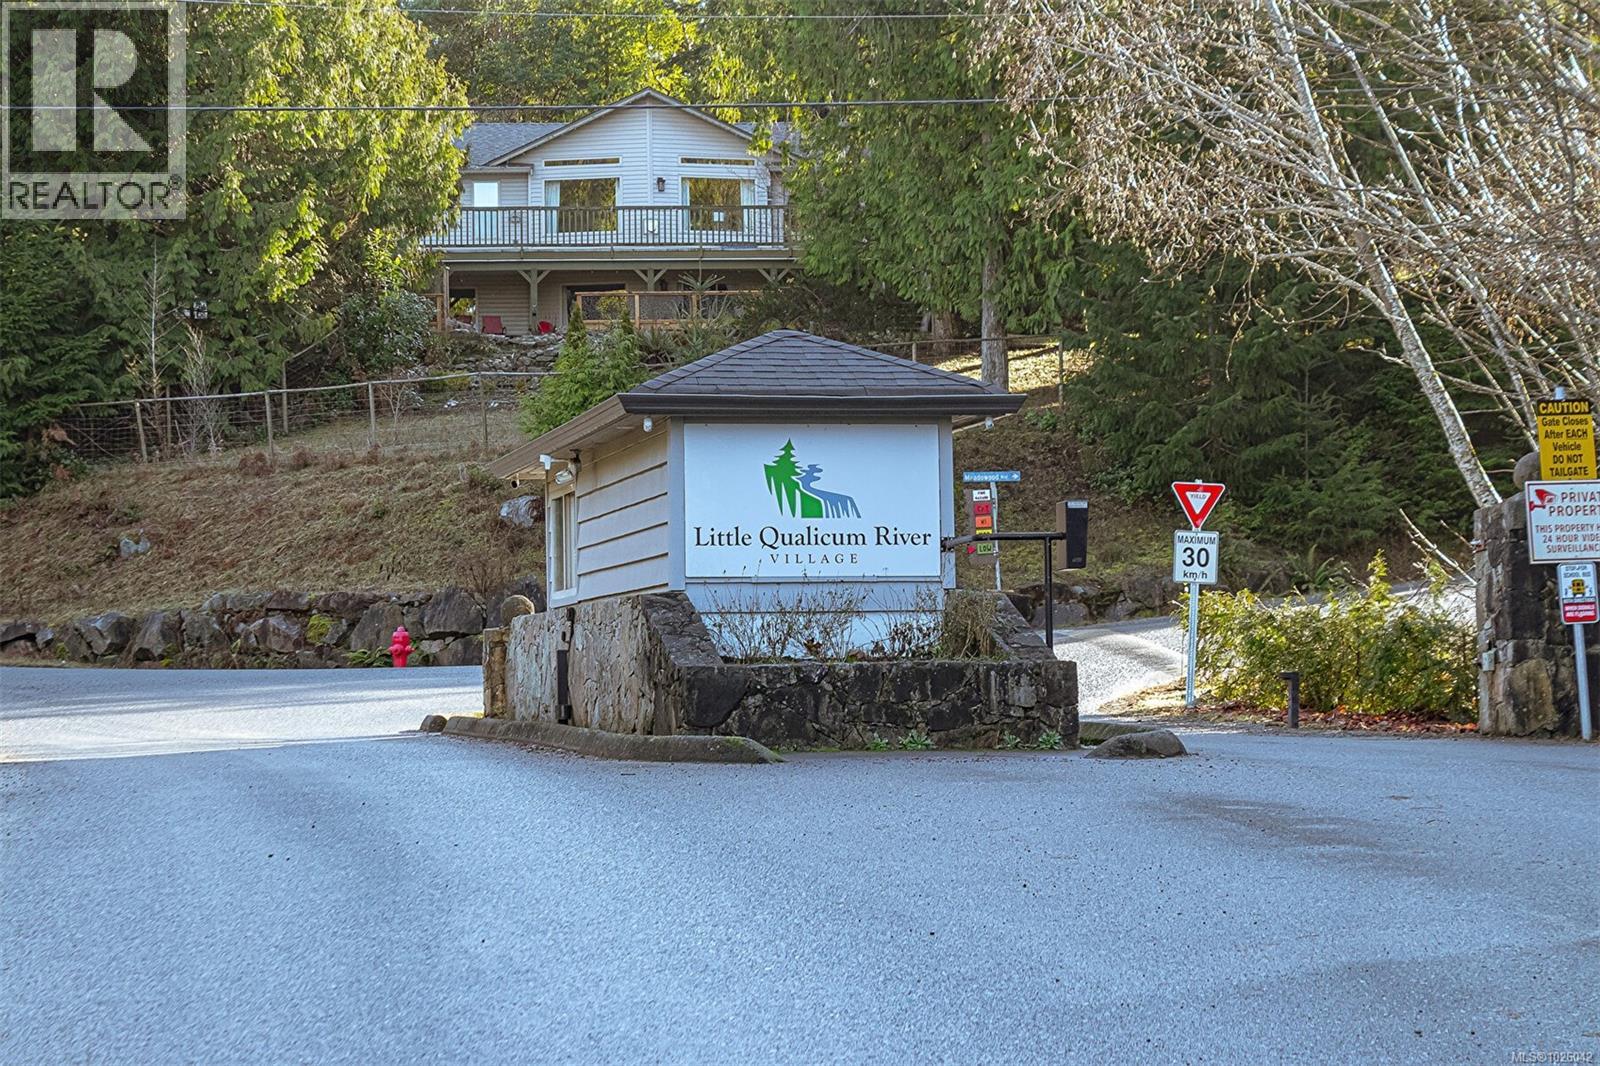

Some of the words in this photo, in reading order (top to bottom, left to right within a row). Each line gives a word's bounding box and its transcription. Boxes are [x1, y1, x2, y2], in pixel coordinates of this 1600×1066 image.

[1540, 401, 1589, 414] CAUTION
[1542, 417, 1560, 426] Gate
[1562, 416, 1589, 426] Closes
[1544, 430, 1563, 439] After
[1566, 428, 1588, 438] EACH
[1553, 442, 1581, 451] Vehicle
[1553, 455, 1564, 464] DO
[1567, 454, 1583, 464] NOT
[1549, 466, 1589, 476] TAILGATE
[1535, 524, 1553, 533] THIS
[1555, 523, 1594, 532] PROPERTY
[694, 526, 752, 547] Little
[759, 526, 867, 550] Qualicum
[874, 526, 932, 546] River
[1177, 535, 1216, 545] MAXIMUM
[1543, 534, 1552, 543] 24
[1556, 533, 1579, 542] HOUR
[979, 545, 992, 553] LOW
[770, 553, 859, 564] VILLAGE
[1182, 547, 1210, 567] 30
[1183, 570, 1208, 579] km/h
